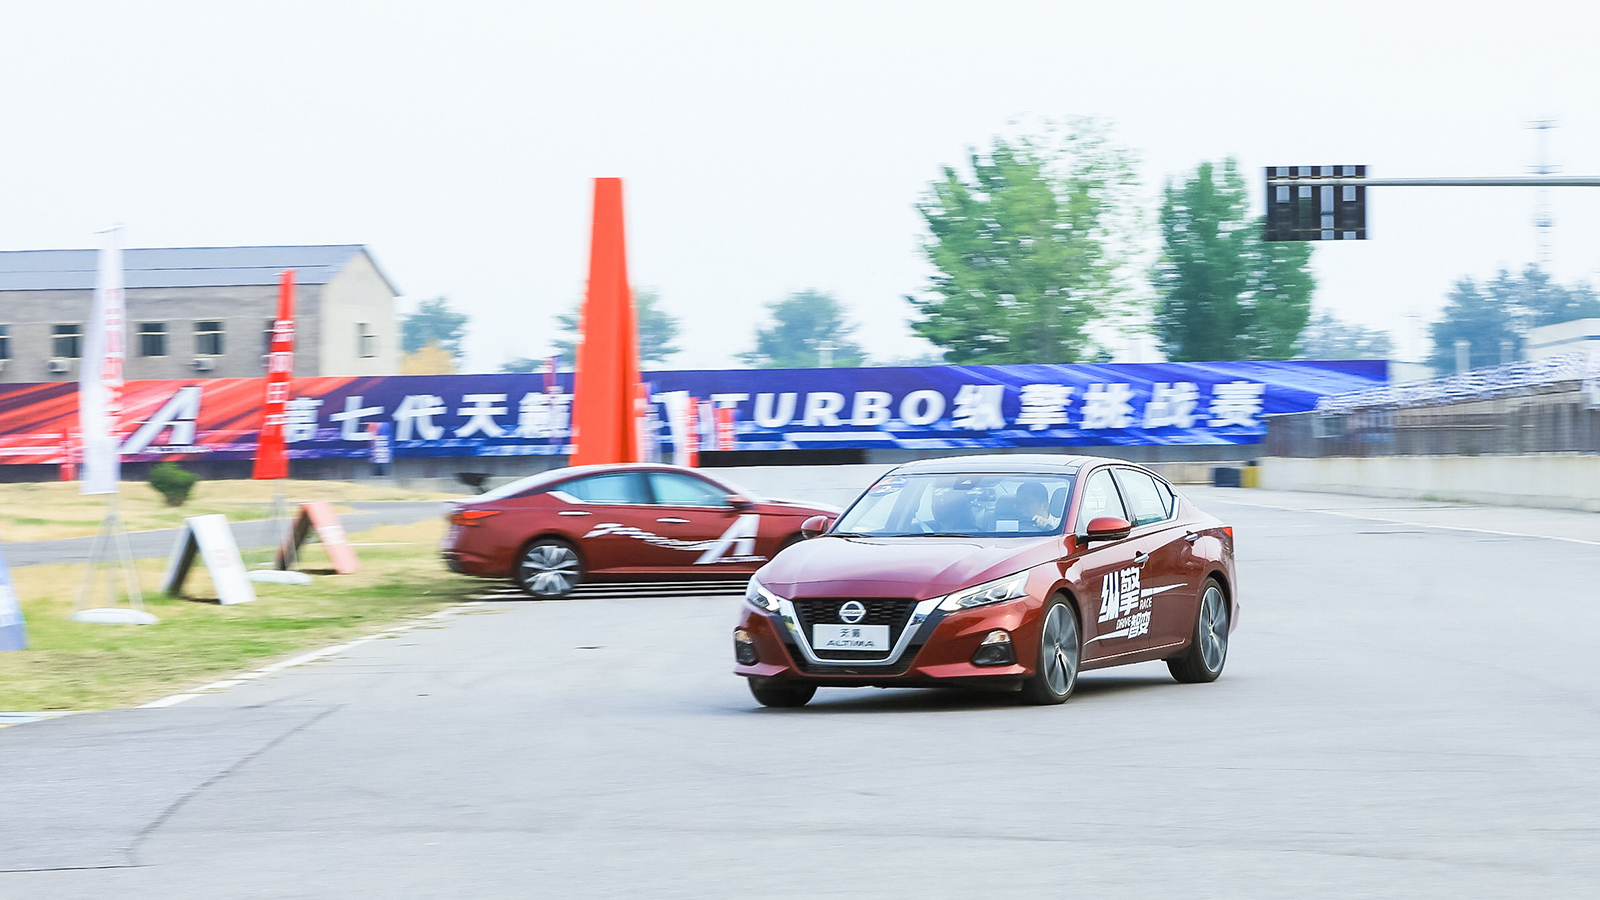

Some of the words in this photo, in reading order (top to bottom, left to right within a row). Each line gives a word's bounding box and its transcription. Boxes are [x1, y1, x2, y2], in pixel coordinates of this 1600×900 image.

[1098, 567, 1140, 623] 纵擎
[1139, 597, 1152, 610] RACE
[1116, 616, 1131, 630] DRIVE
